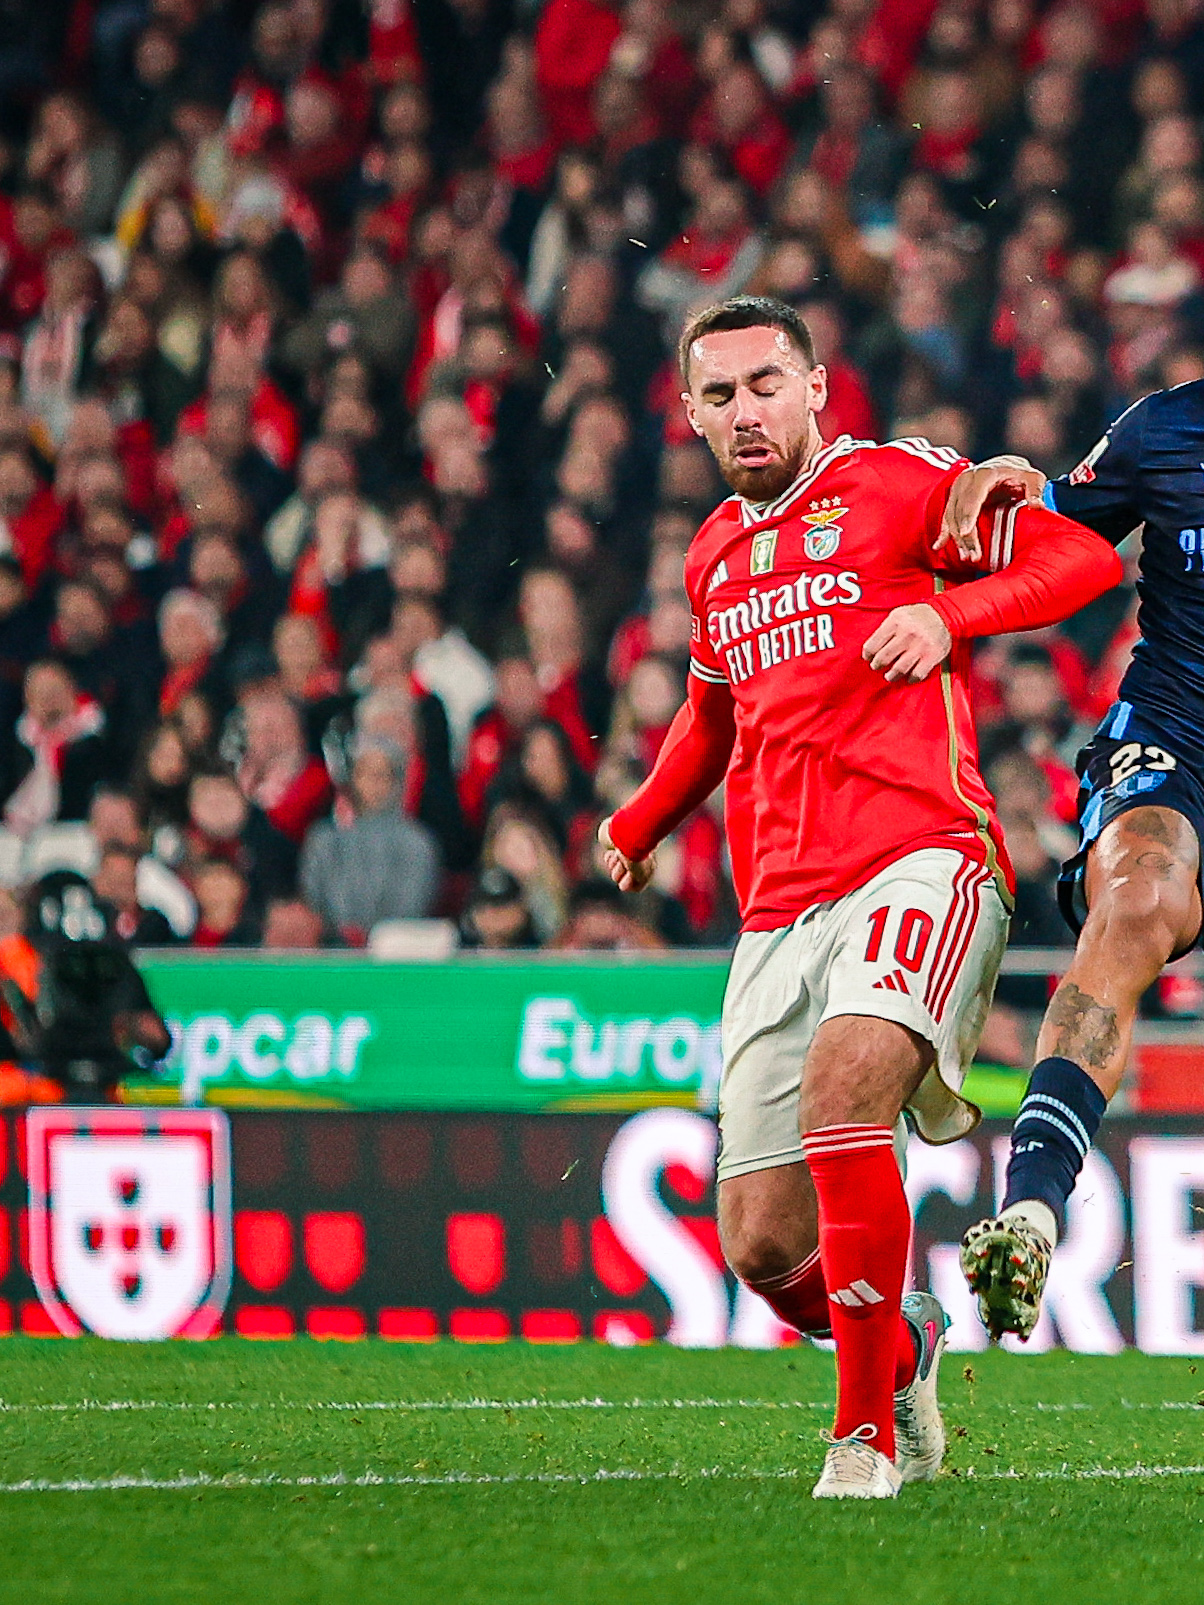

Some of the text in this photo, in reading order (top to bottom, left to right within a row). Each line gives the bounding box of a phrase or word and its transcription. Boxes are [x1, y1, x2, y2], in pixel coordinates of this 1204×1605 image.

[707, 571, 862, 655] Emirates
[725, 638, 754, 686] FLY
[757, 613, 835, 670] BETTER
[864, 905, 934, 974] 10
